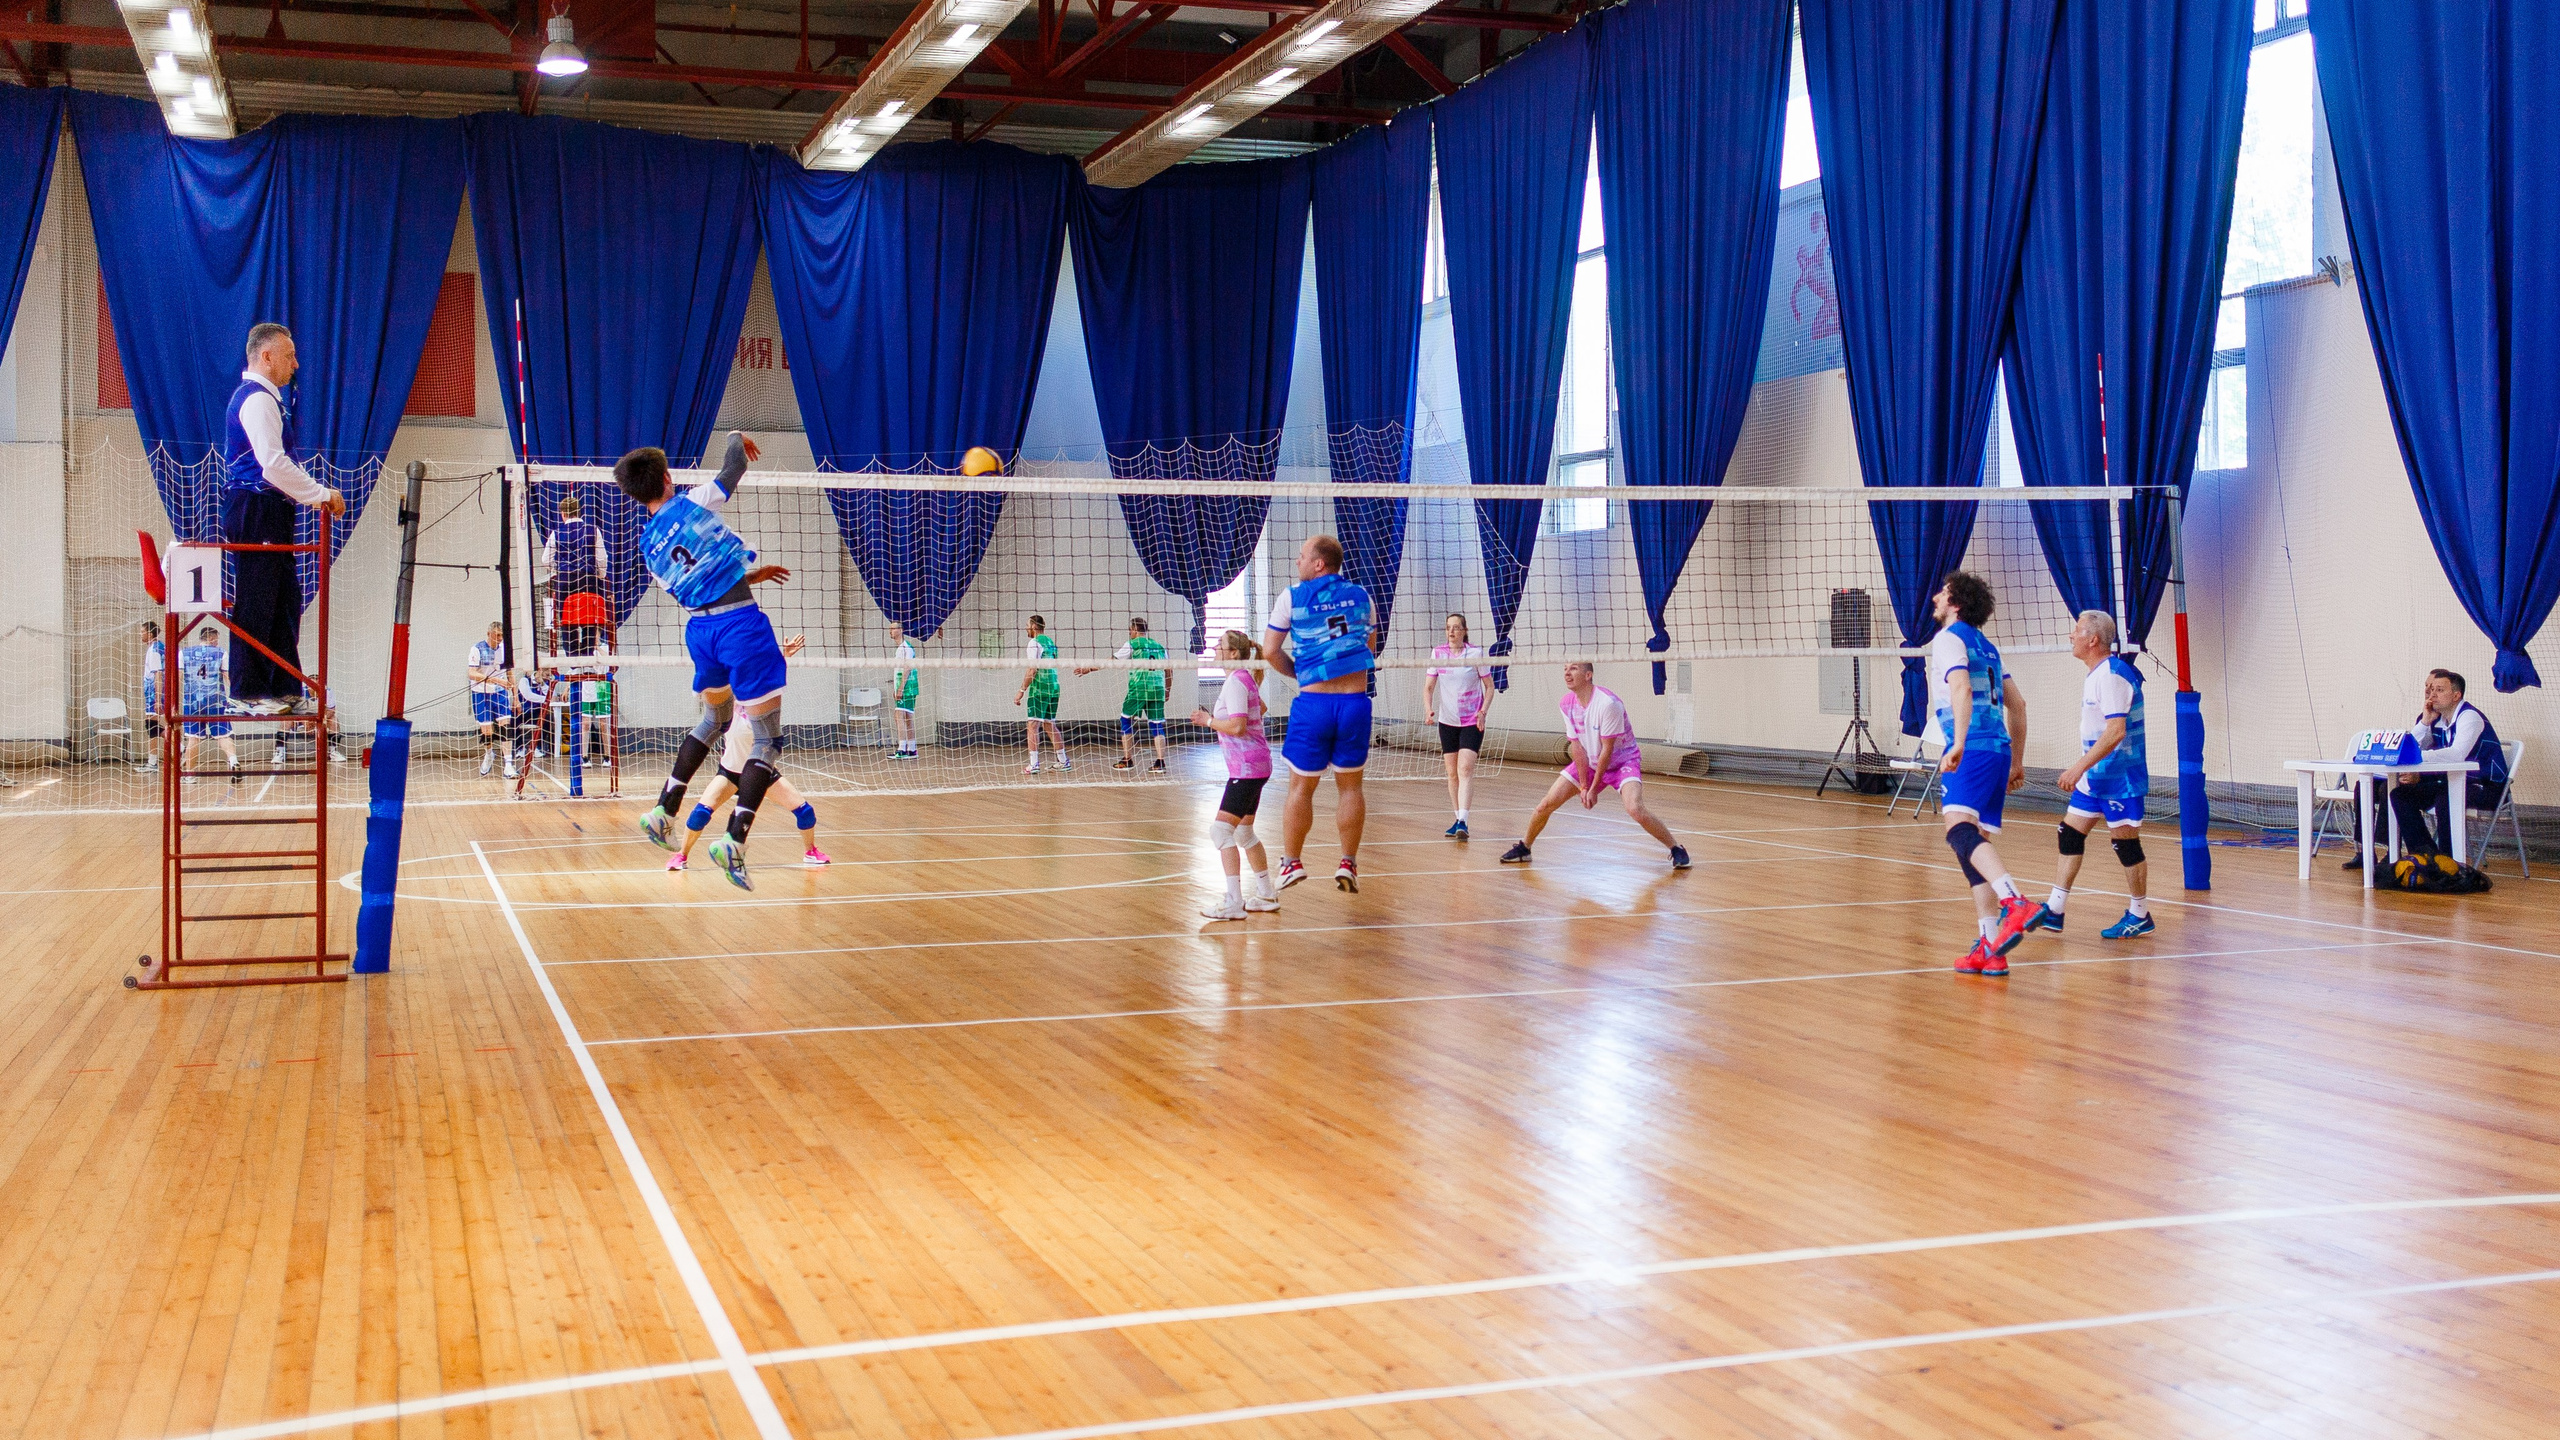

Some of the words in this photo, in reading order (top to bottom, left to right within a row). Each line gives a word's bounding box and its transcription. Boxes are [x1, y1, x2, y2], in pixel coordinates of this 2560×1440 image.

[735, 337, 773, 369] ИЯ
[670, 545, 698, 574] 3
[187, 565, 208, 604] 1
[1327, 614, 1348, 640] 5
[197, 663, 207, 680] 4
[2363, 733, 2371, 749] 3
[2374, 733, 2381, 742] 0
